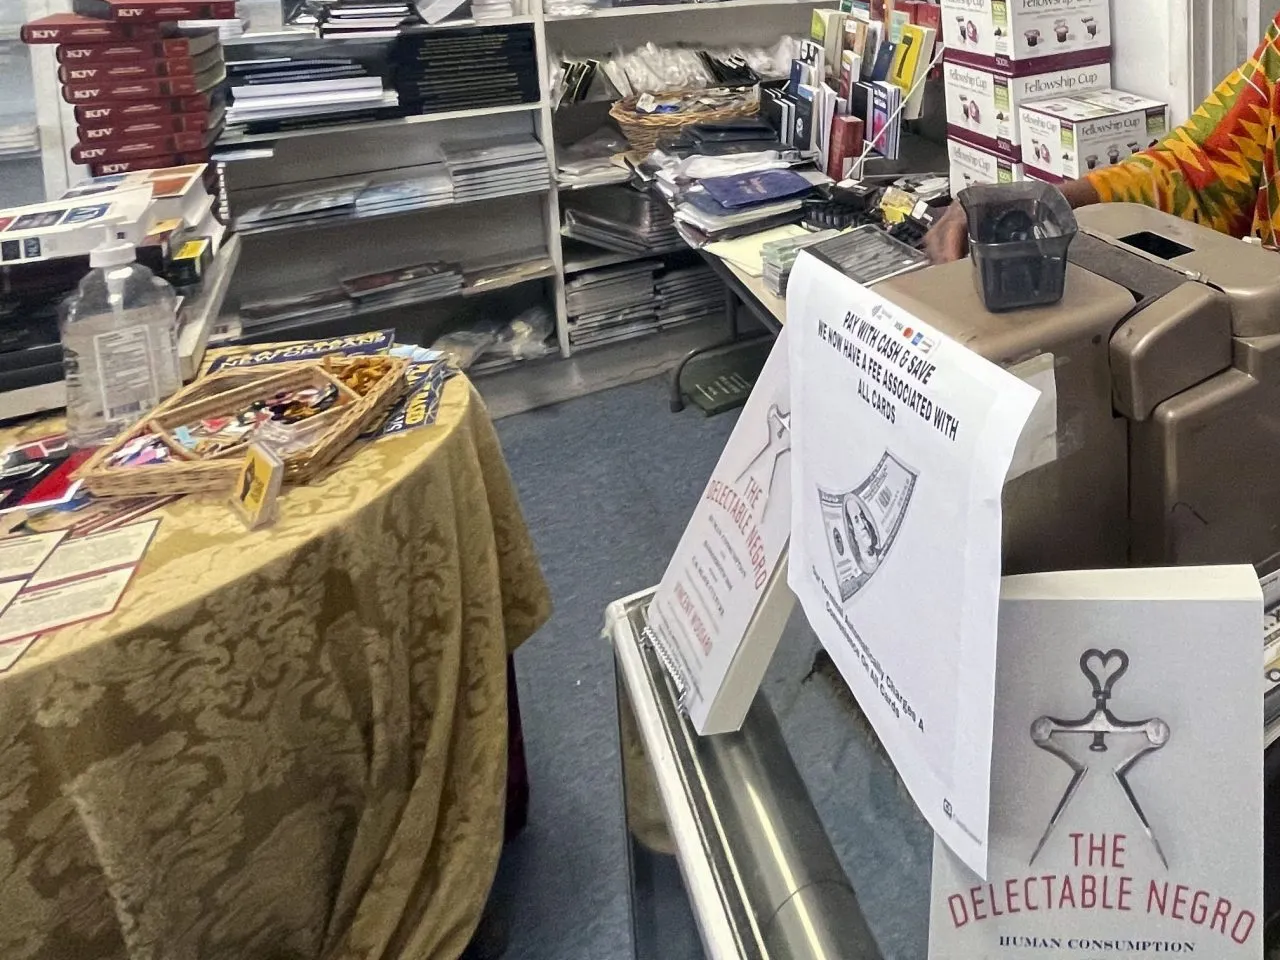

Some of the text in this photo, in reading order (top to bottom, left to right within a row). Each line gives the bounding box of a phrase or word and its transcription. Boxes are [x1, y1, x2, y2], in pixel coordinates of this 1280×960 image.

[117, 9, 144, 17] KJV
[32, 30, 60, 38] KJV
[67, 49, 92, 58] KJV
[70, 69, 97, 78] KJV
[949, 68, 987, 89] Fellowship Cup
[1024, 73, 1098, 93] Fellowship Cup
[74, 89, 100, 98] KJV
[85, 109, 111, 118] KJV
[87, 128, 113, 138] KJV
[1081, 117, 1140, 136] Fellowship Cup
[80, 148, 107, 159] KJV
[103, 162, 130, 174] KJV
[220, 334, 387, 369] NEW ORLEANS
[843, 311, 859, 335] PAY
[857, 320, 880, 347] WITH
[877, 334, 903, 364] CASH
[899, 349, 910, 368] &
[907, 355, 936, 385] SAVE
[818, 319, 960, 442] WE NOW HAVE A FEE ASSOCIATED WITH
[857, 378, 896, 425] ALL CARDS
[743, 476, 763, 509] THE
[706, 479, 752, 535] DELECTABLE
[745, 525, 768, 591] NEGRO
[879, 683, 900, 719] Cards
[886, 675, 917, 723] Charges
[1068, 833, 1127, 868] THE
[947, 874, 1256, 945] DELECTABLE NEGRO
[999, 935, 1197, 954] HUMAN CONSUMPTION
